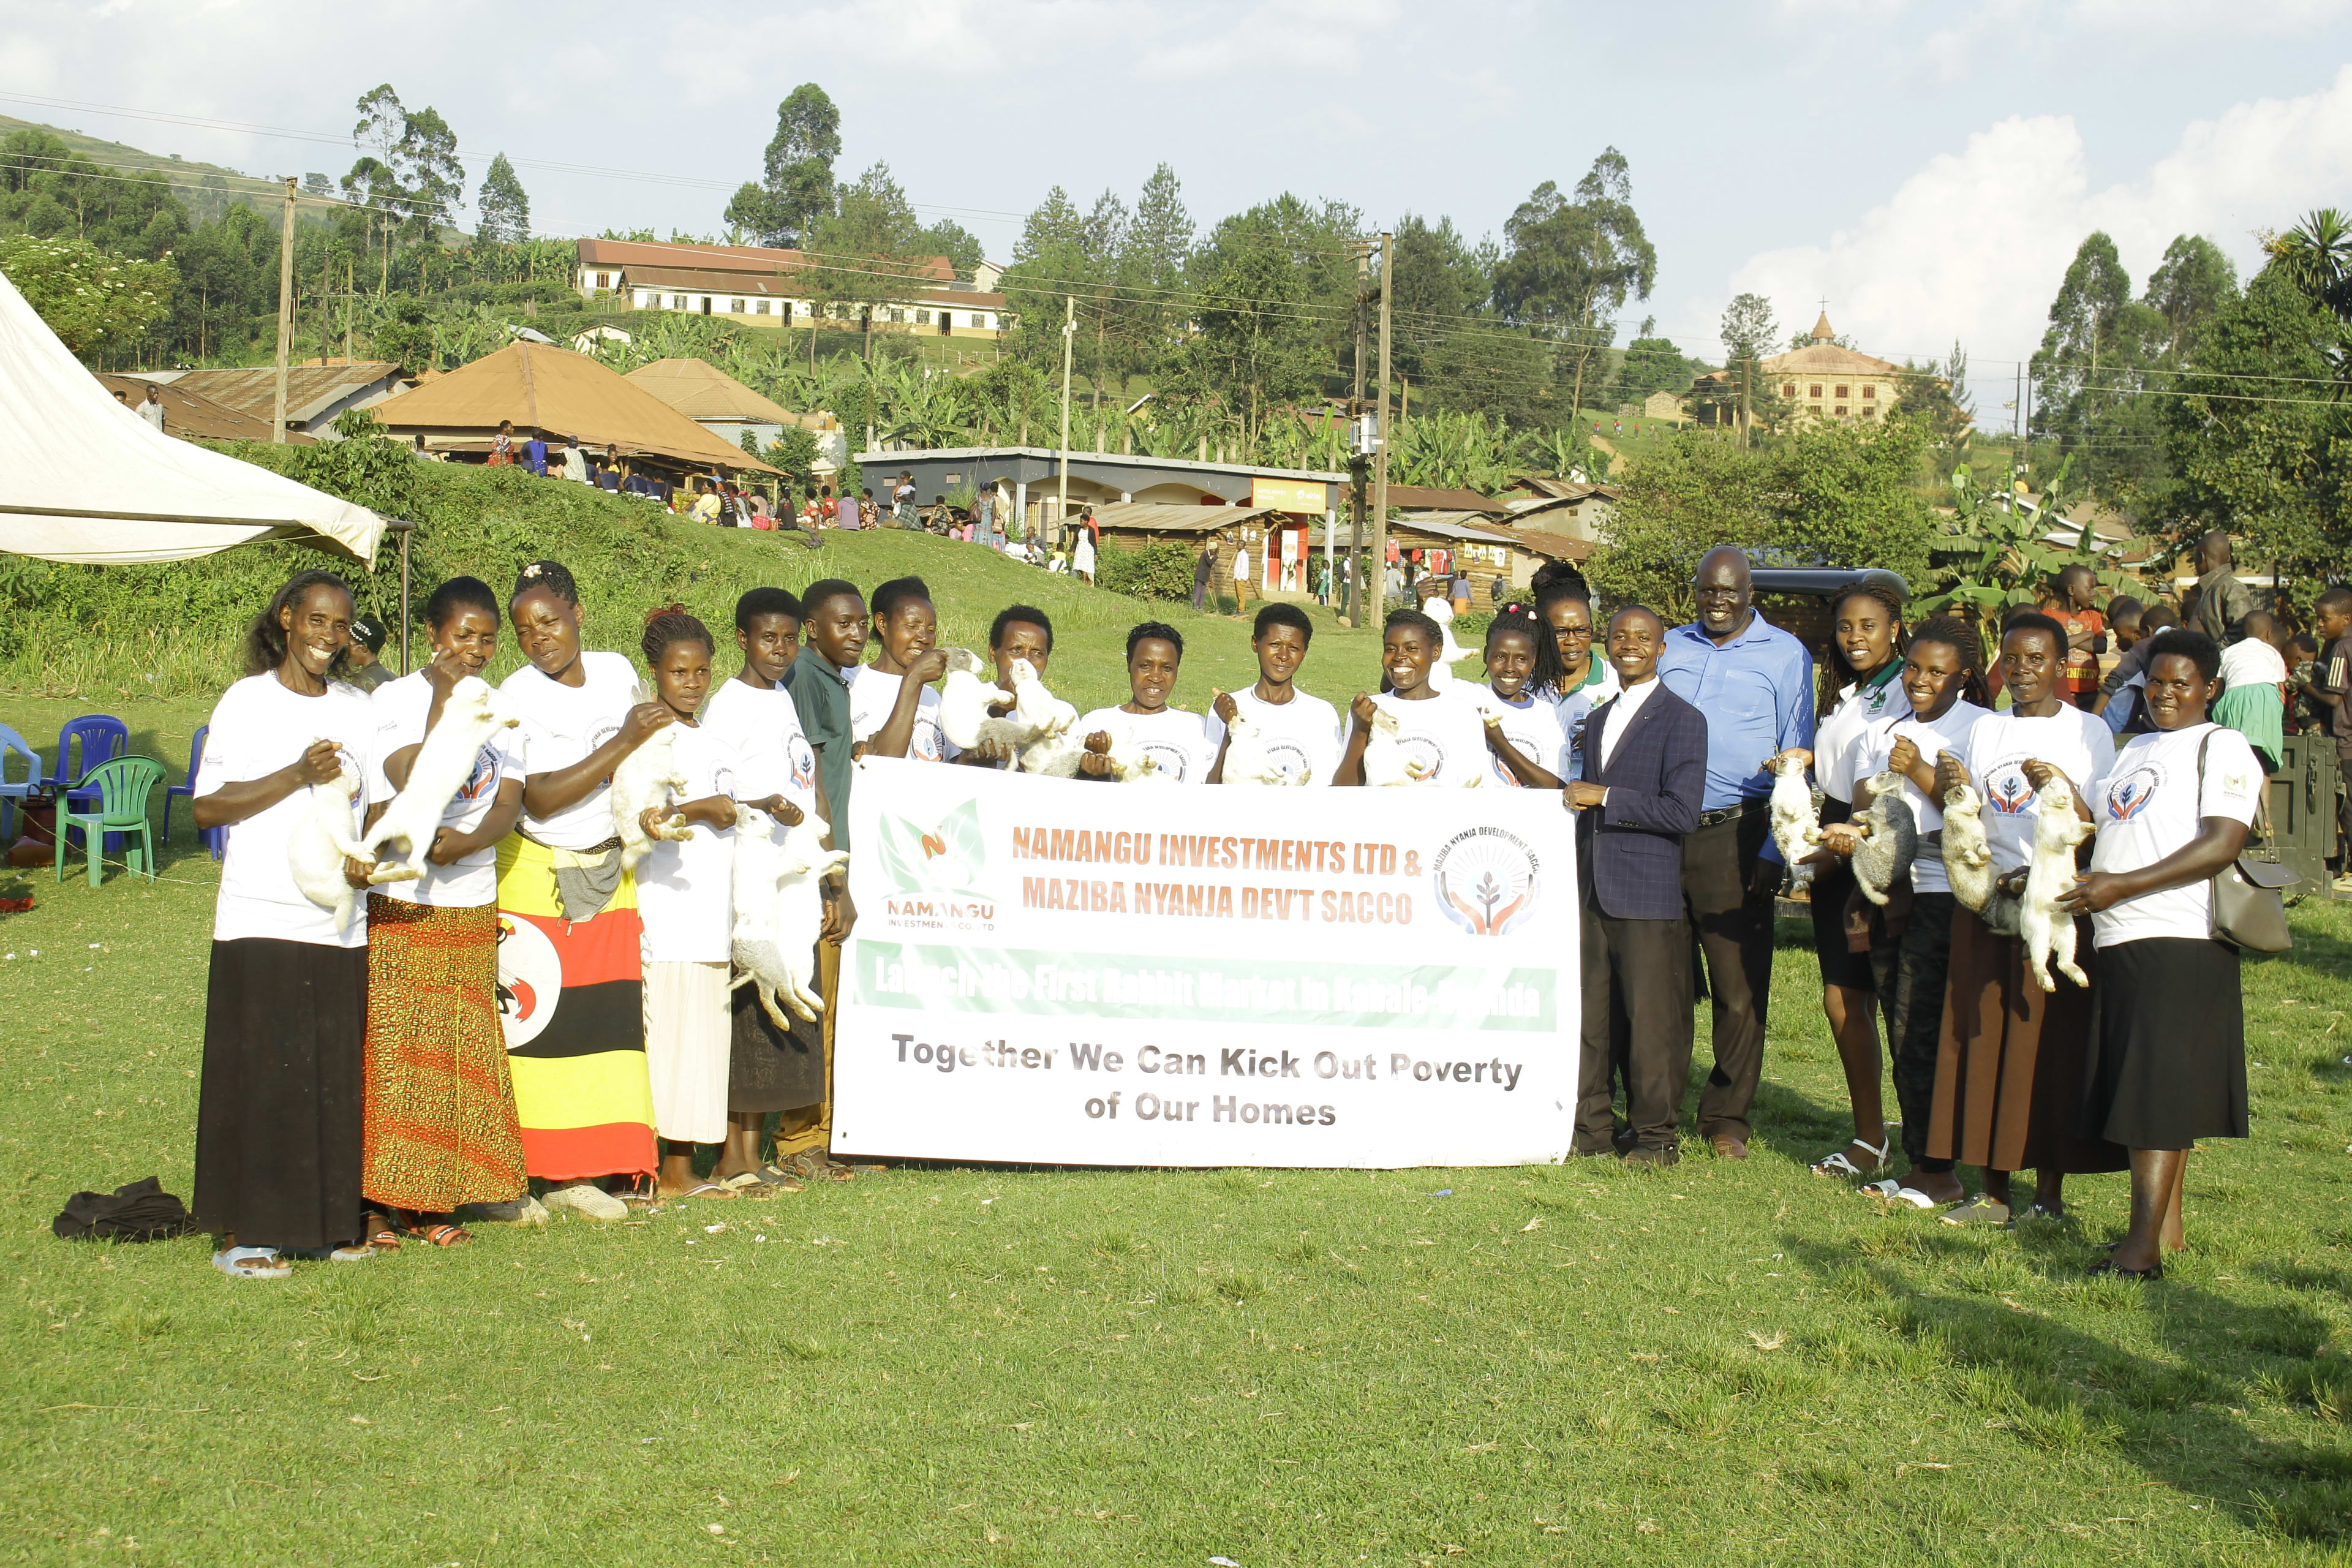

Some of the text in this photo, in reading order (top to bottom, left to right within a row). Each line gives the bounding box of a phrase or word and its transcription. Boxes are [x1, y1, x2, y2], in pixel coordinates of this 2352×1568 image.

[1012, 826, 1422, 877] NAMANGU INVESTMENTS LTD &
[1433, 845, 1452, 872] MAZIBA
[1449, 828, 1477, 847] NYANJA
[1479, 826, 1528, 850] DEVELOPMENT
[1022, 876, 1412, 925] MAZIBA NYANJA DEV'T SACCO
[875, 956, 977, 997] Lanch
[892, 1033, 1523, 1092] Together We Can Kick Out Poverty
[1084, 1091, 1336, 1126] of Our Homes
